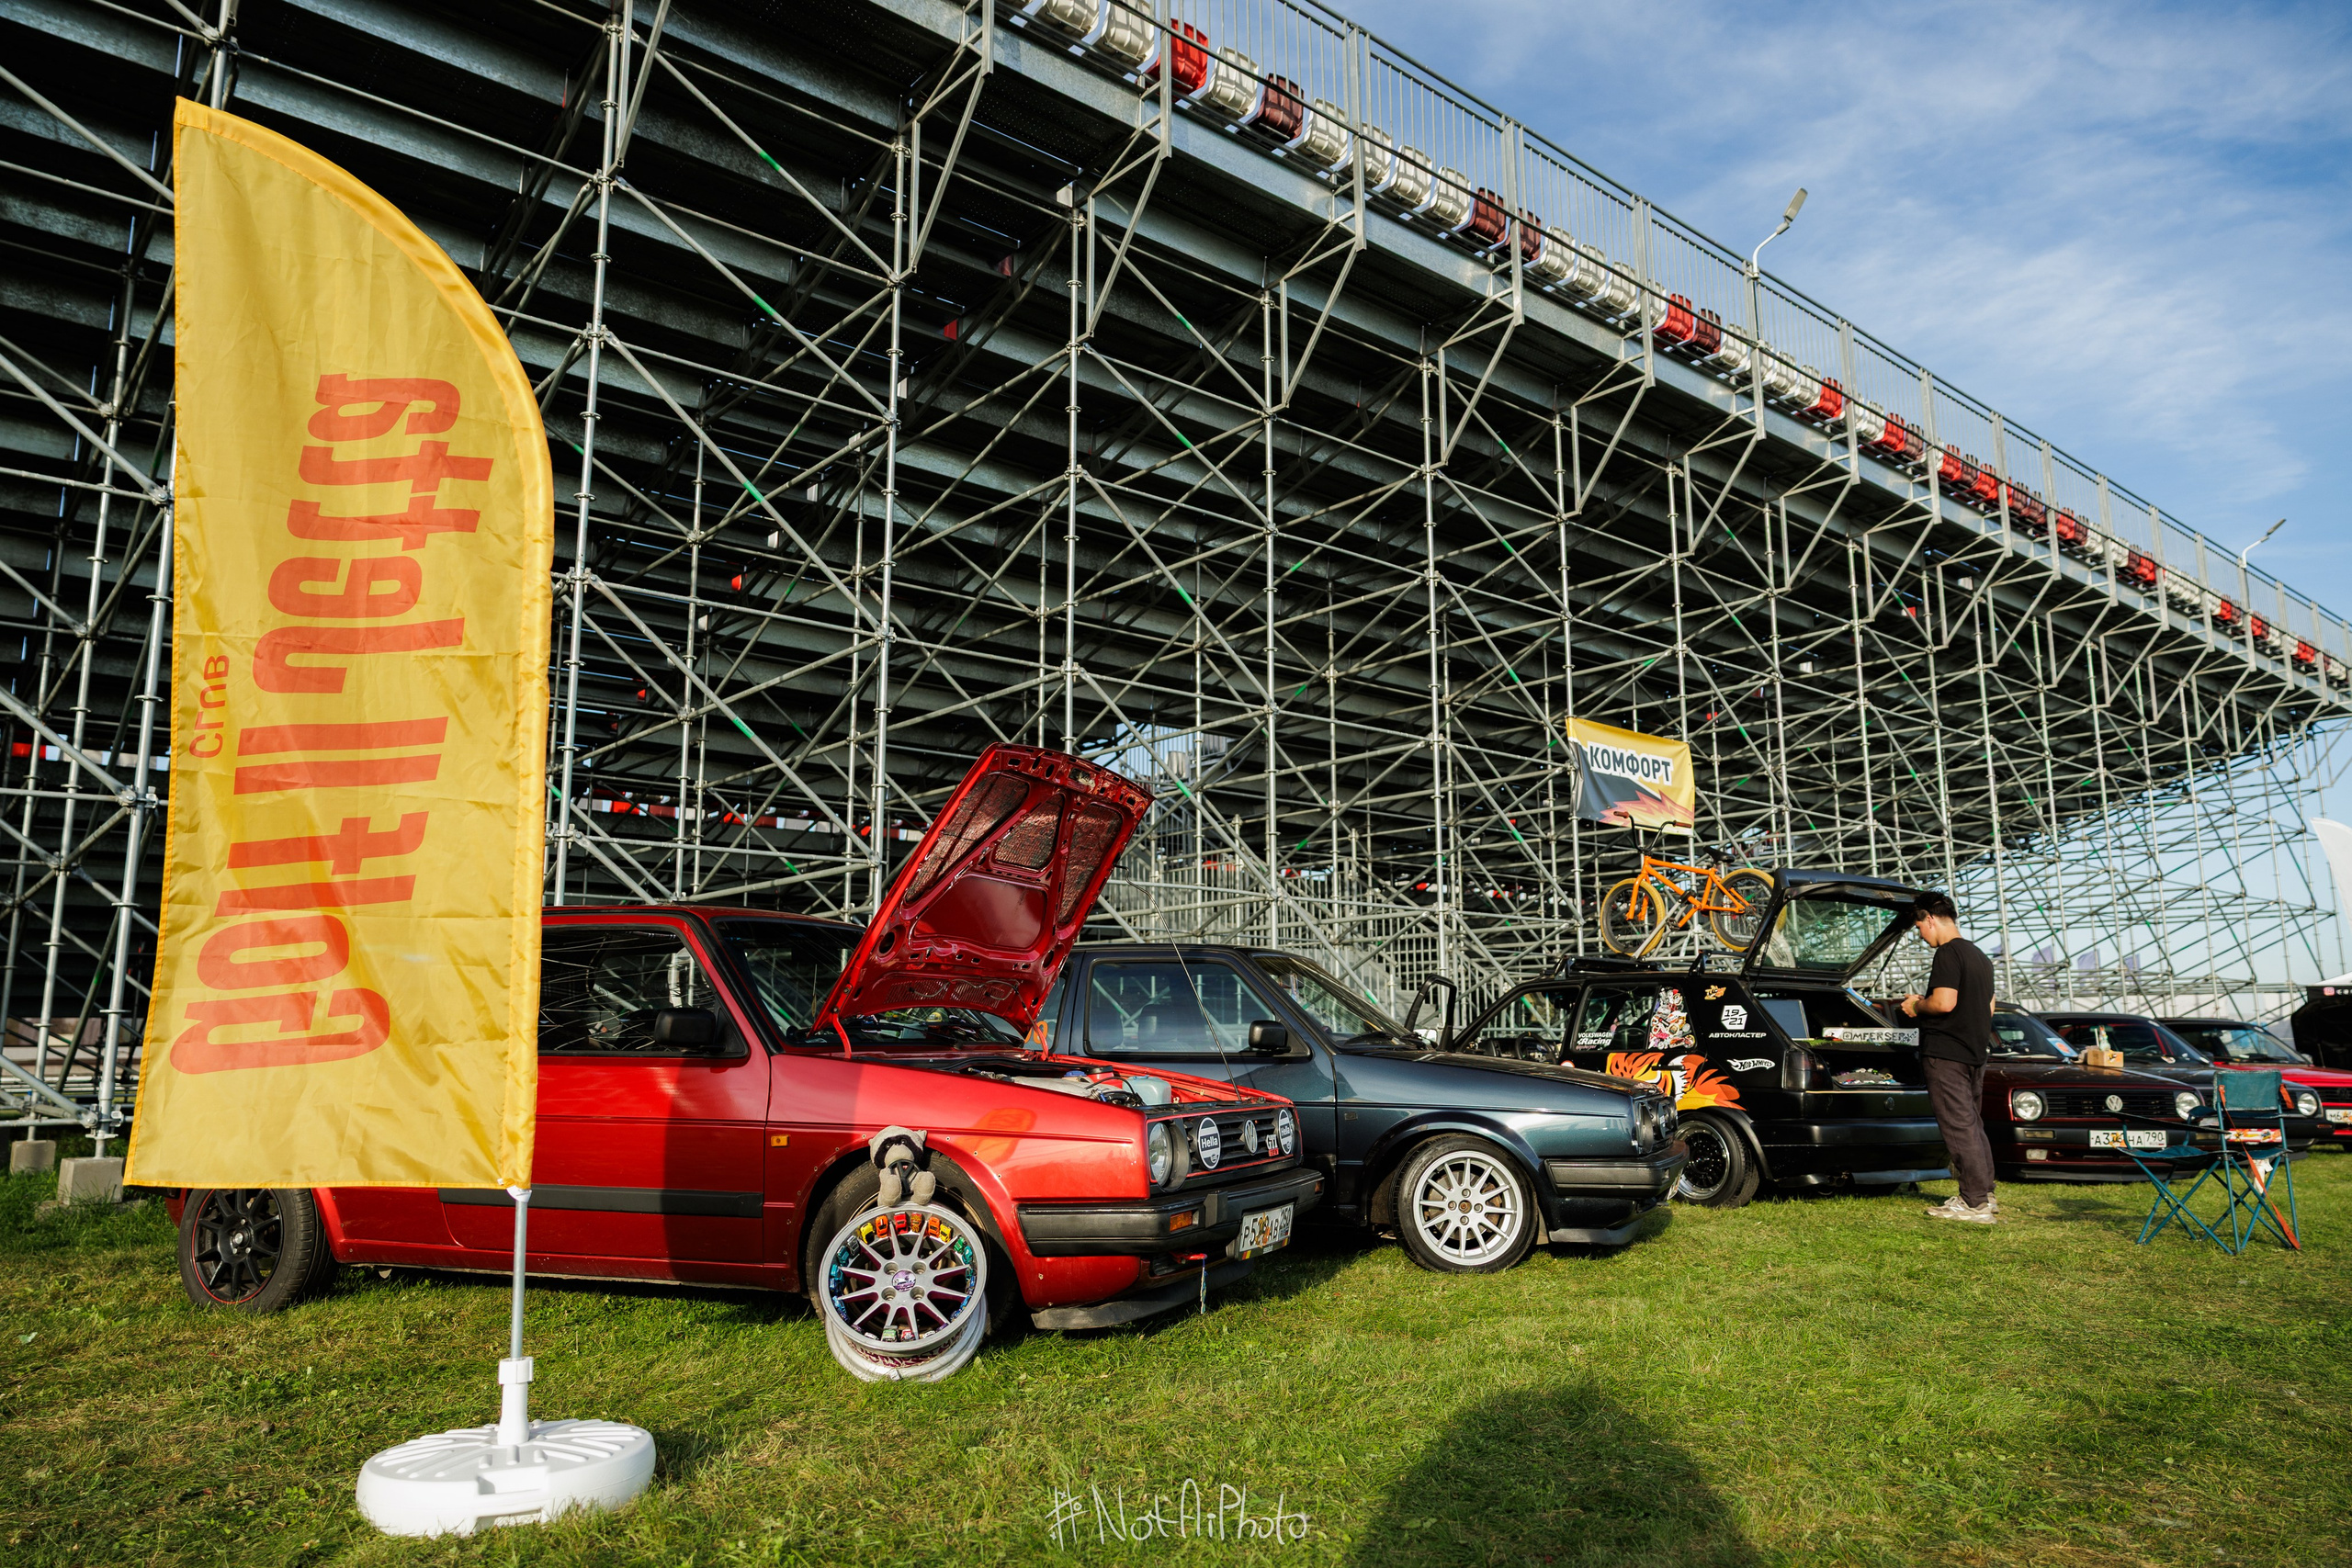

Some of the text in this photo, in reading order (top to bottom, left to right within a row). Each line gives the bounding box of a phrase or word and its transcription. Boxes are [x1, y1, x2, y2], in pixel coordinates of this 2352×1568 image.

[1589, 745, 1670, 782] КОМФОРТ
[1724, 1009, 1740, 1017] 19
[1728, 1017, 1744, 1026] 21
[1281, 1124, 1291, 1137] Hella
[2145, 1132, 2164, 1142] 790
[1201, 1136, 1218, 1149] Hella
[1267, 1136, 1278, 1150] GTI
